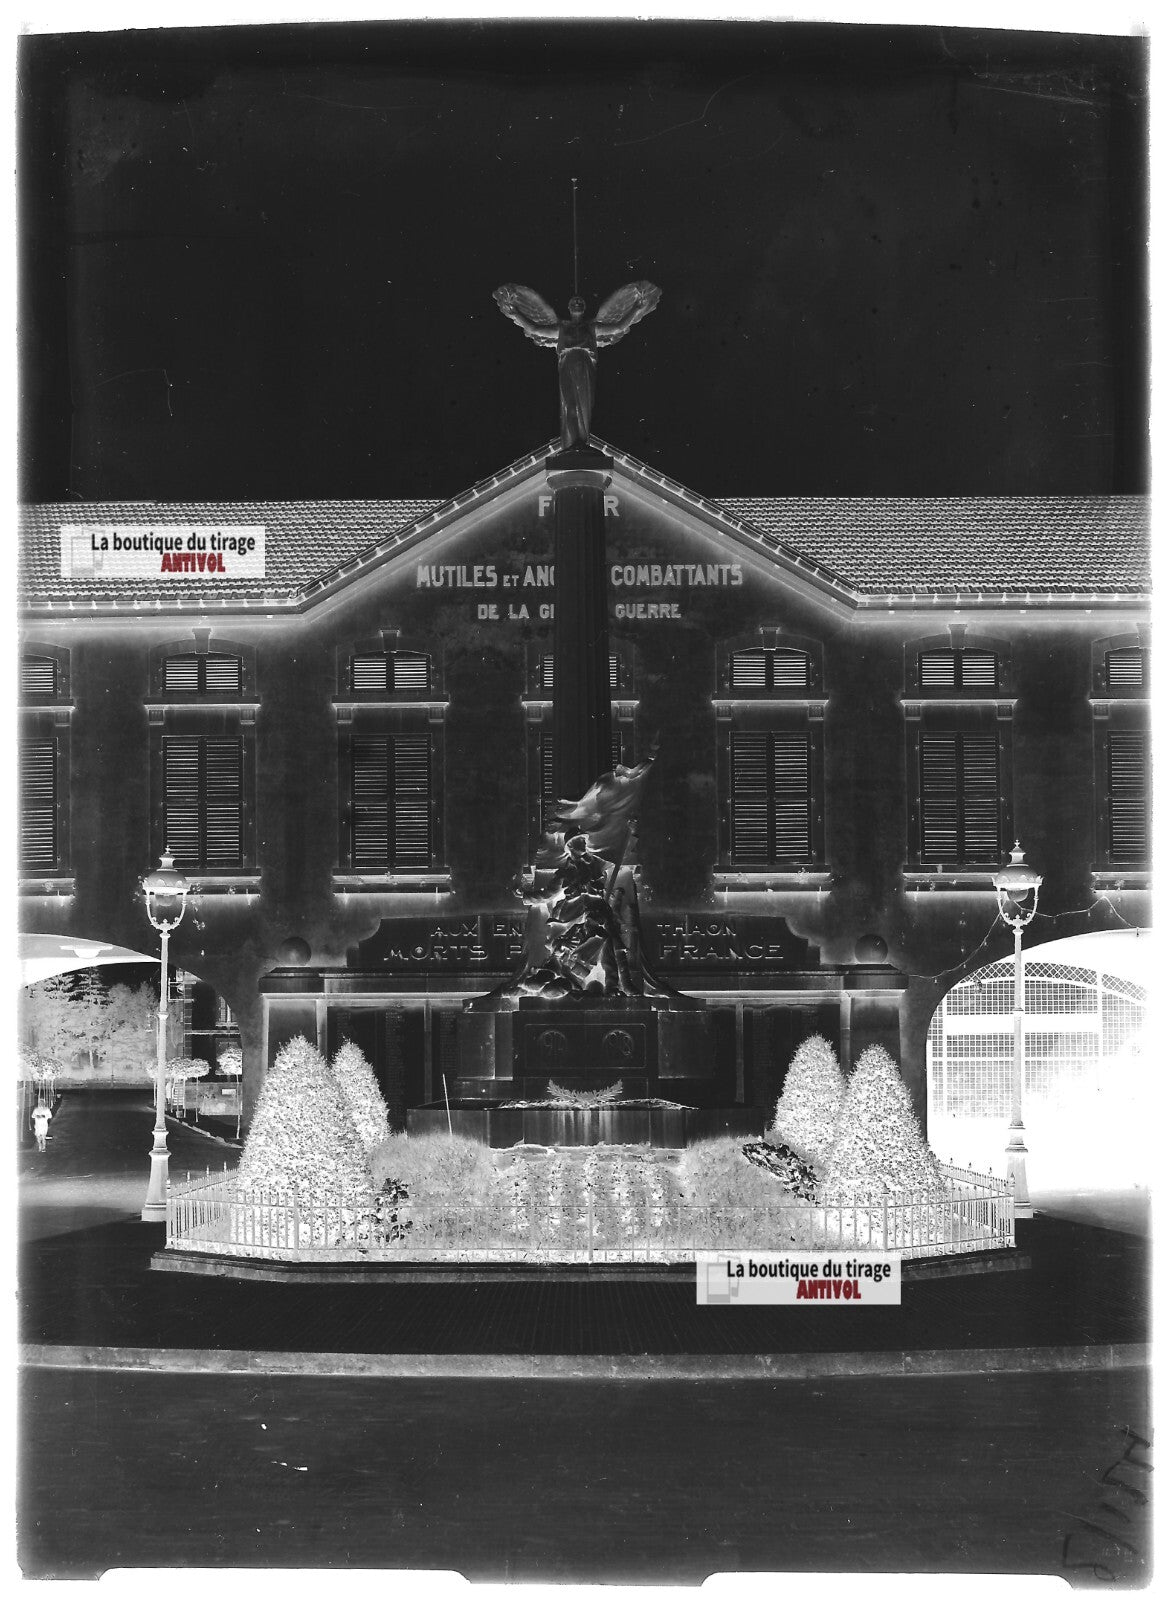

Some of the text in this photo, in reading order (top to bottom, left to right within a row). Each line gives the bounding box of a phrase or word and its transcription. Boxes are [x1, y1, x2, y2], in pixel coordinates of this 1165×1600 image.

[416, 565, 498, 588] MUTILES
[502, 574, 520, 588] ET
[610, 564, 743, 586] COMBATTANTS
[477, 603, 500, 620] DE
[508, 603, 530, 619] LA
[615, 603, 682, 619] GUERRE
[430, 923, 478, 937] AUX
[657, 924, 736, 937] THAON
[383, 945, 489, 961] MORTS
[659, 945, 784, 960] FRANCE
